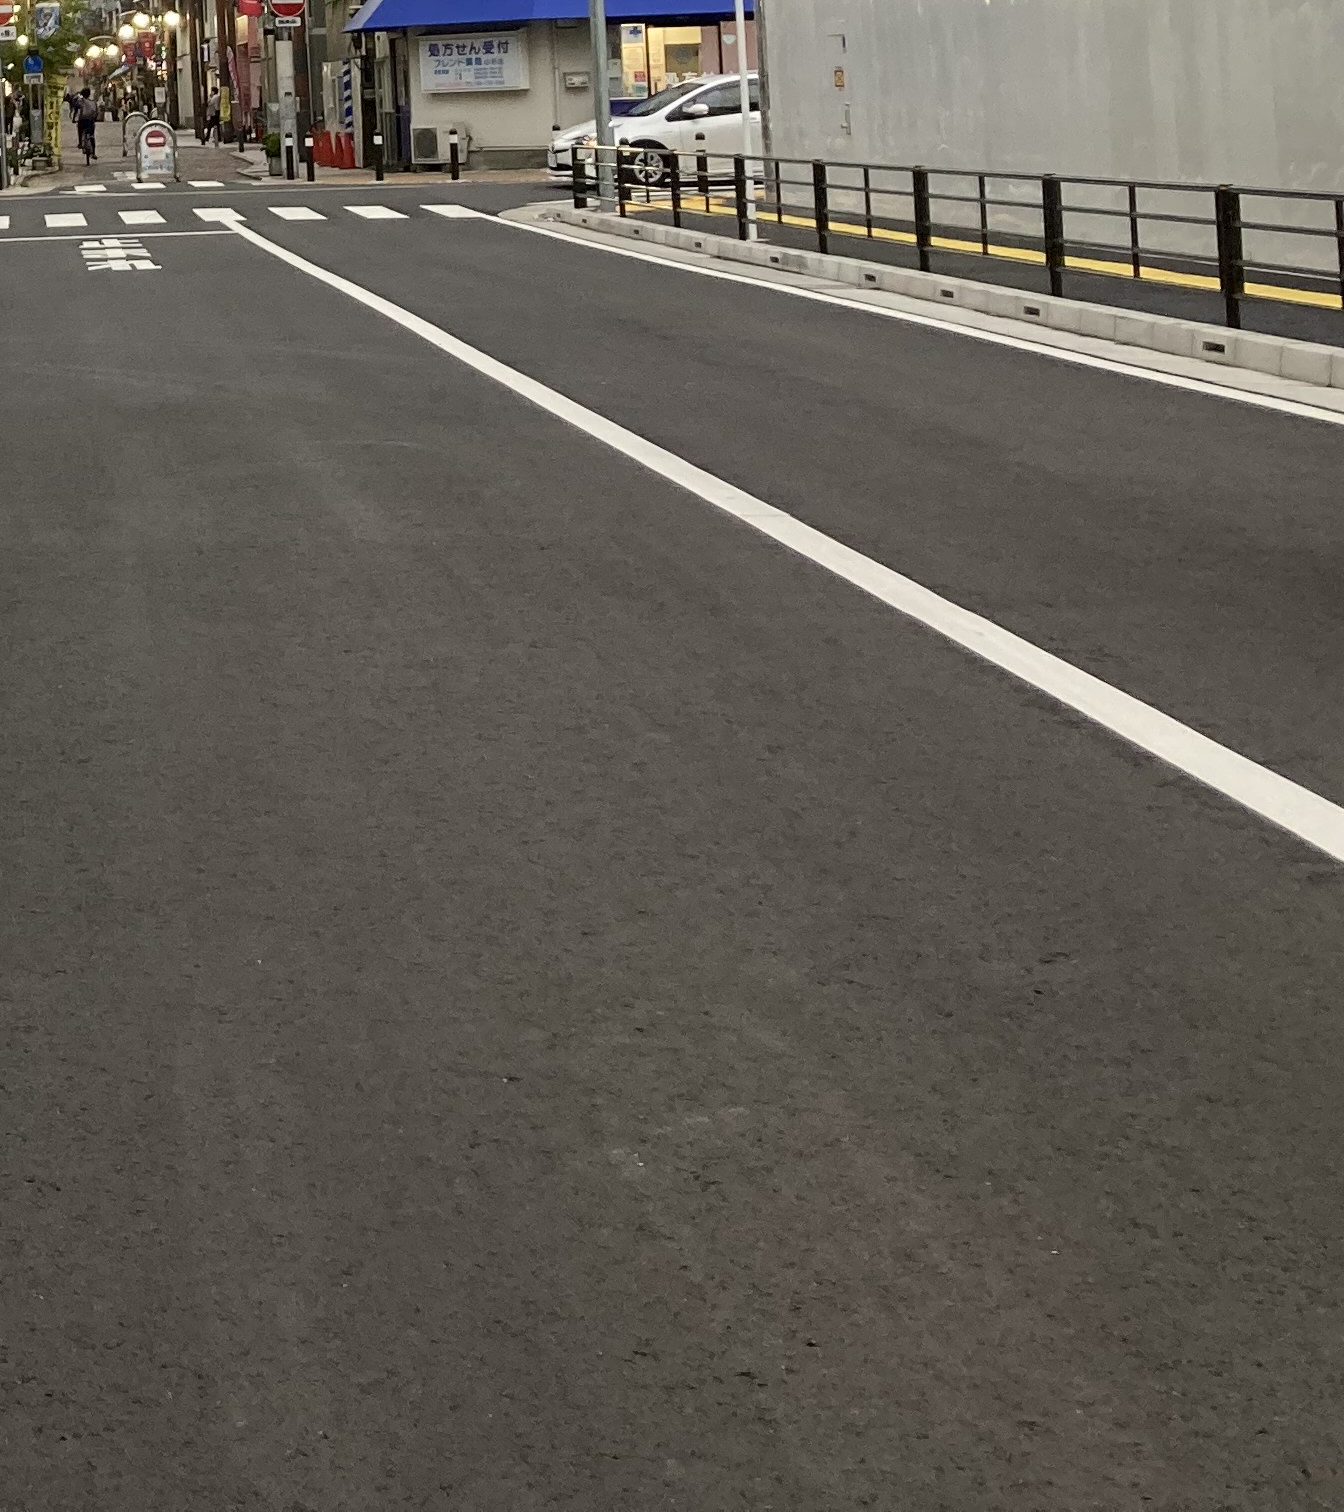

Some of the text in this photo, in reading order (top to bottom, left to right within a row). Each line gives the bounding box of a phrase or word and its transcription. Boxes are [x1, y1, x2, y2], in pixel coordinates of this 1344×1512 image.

[428, 40, 509, 58] 処方せん受付
